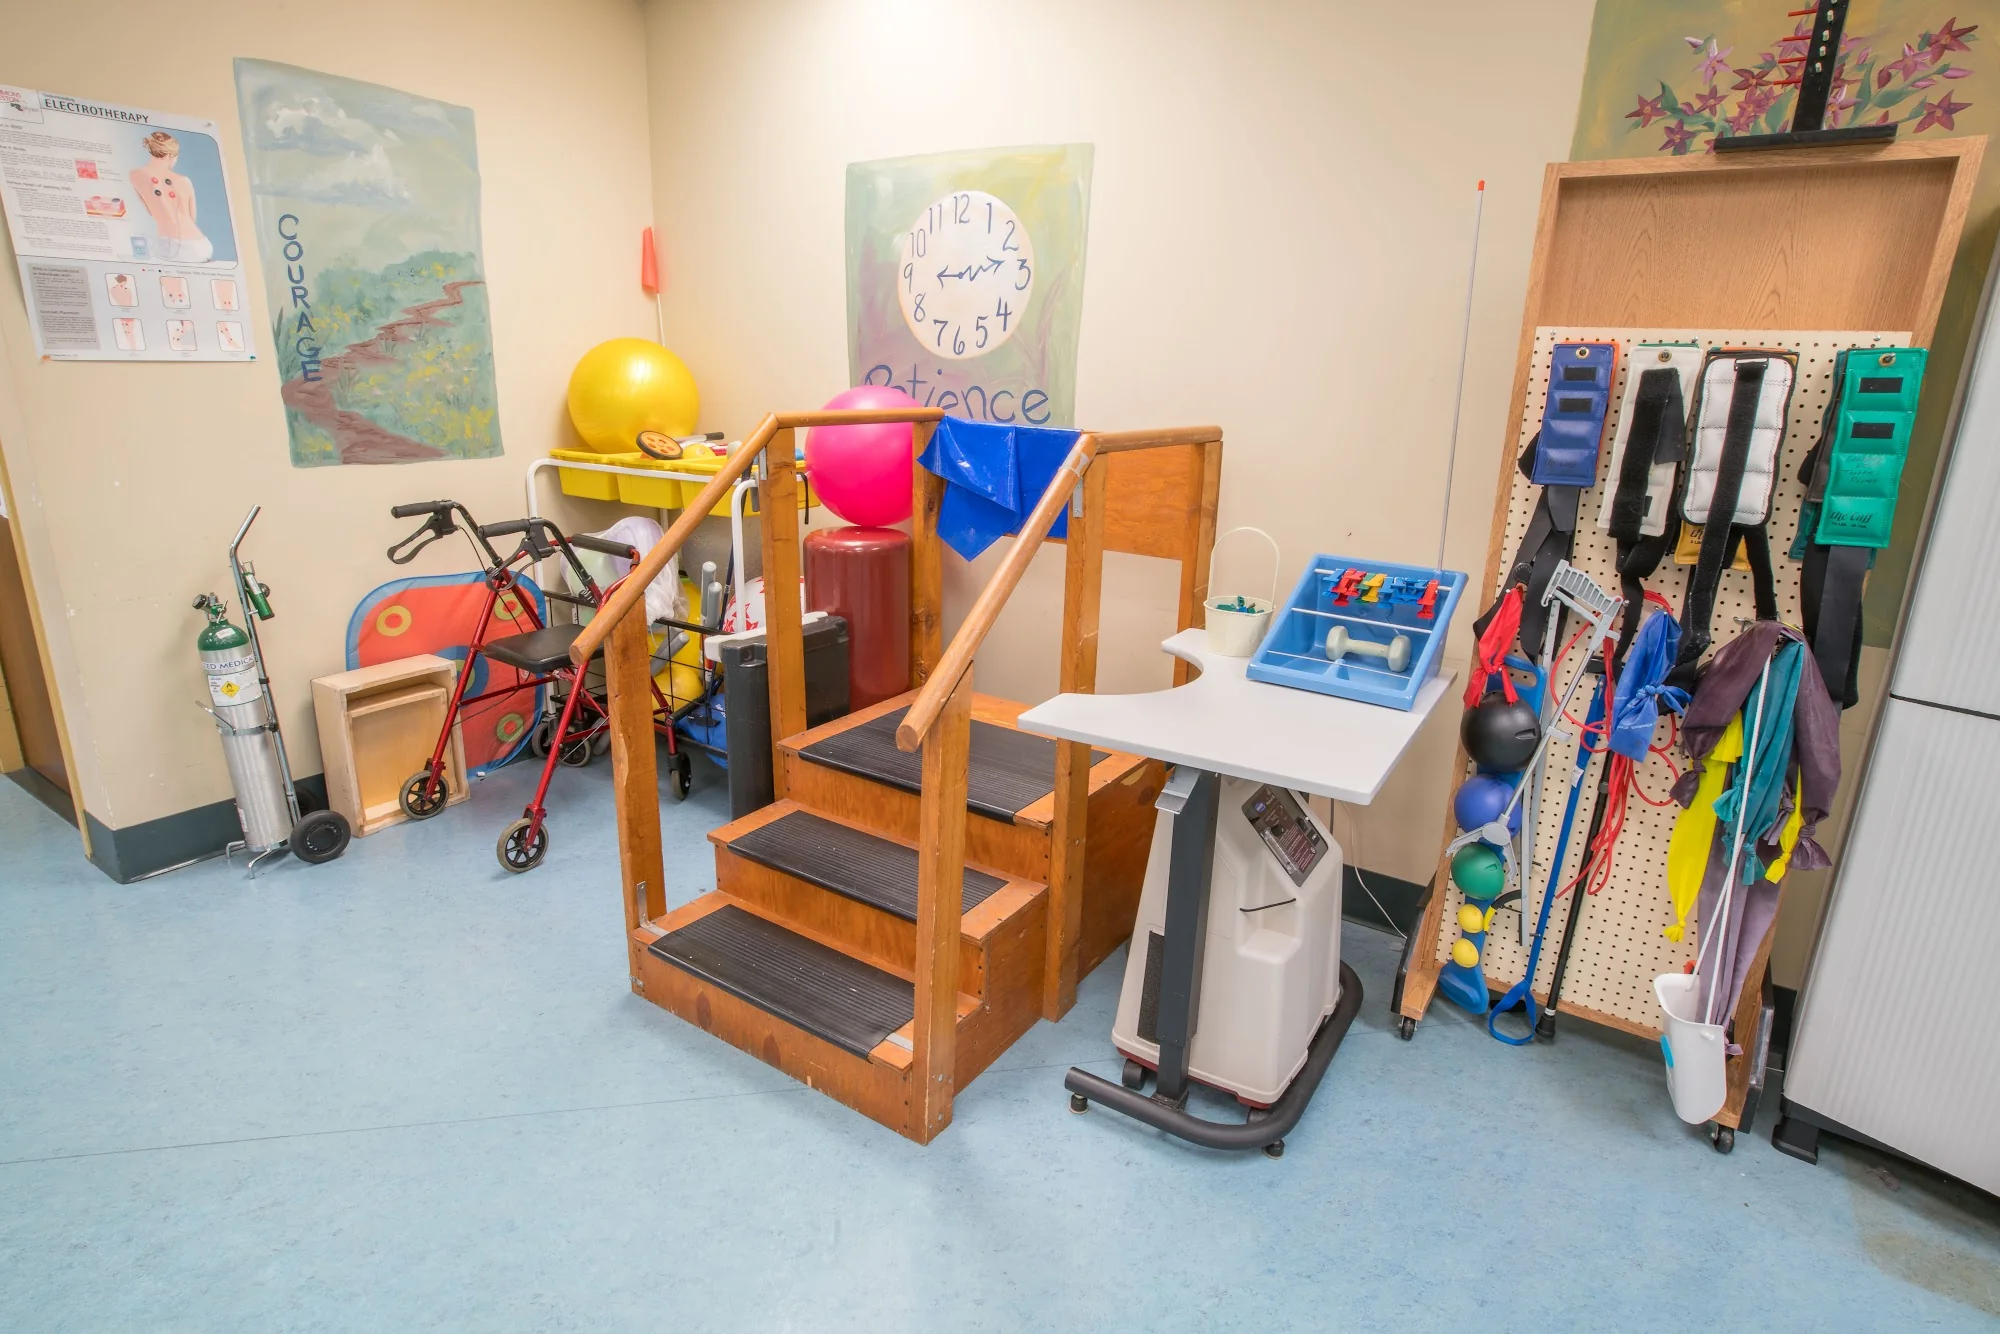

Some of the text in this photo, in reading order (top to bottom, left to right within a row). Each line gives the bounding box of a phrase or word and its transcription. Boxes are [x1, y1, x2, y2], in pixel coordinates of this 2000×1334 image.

[44, 98, 149, 123] ELECTROTHERAPY
[928, 203, 943, 235] 11
[953, 193, 971, 225] 12
[986, 202, 993, 234] 1
[910, 228, 927, 258] 10
[1002, 220, 1020, 252] 2
[903, 262, 913, 293] 9
[1014, 258, 1032, 291] 3
[278, 213, 323, 382] COURAGE
[913, 291, 927, 323] 8
[995, 296, 1012, 332] 4
[933, 319, 949, 347] 7
[953, 325, 965, 356] 6
[975, 315, 988, 348] 5
[865, 363, 1051, 425] Ptience
[1690, 528, 1704, 541] th
